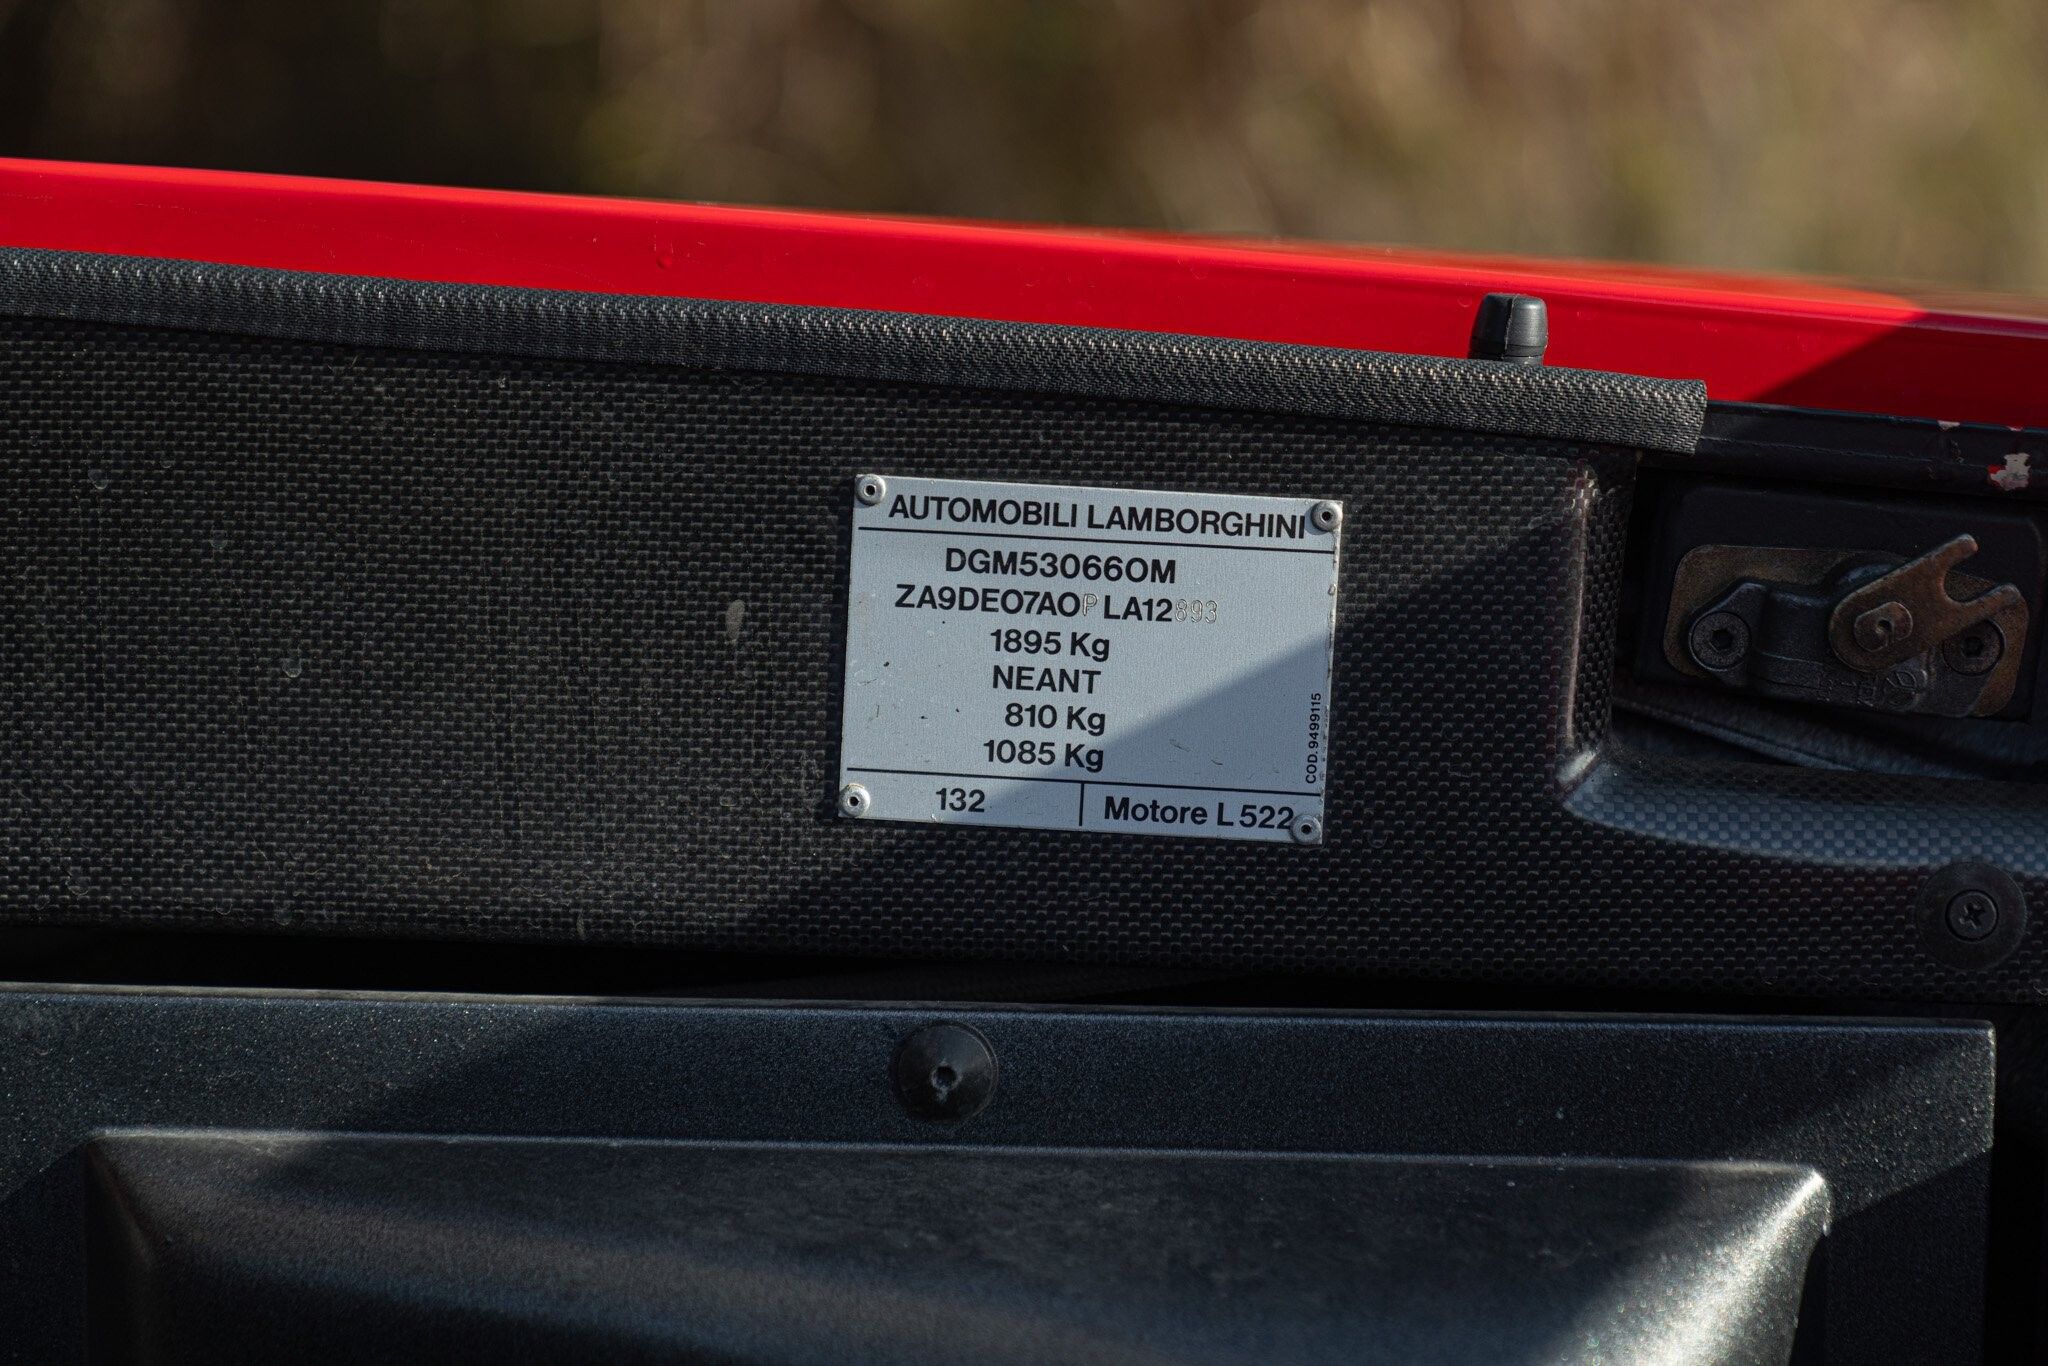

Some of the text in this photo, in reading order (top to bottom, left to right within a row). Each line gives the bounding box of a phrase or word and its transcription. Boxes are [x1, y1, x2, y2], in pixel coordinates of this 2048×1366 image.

[888, 494, 1306, 540] AUTOMOBILI LAMBORGHINI
[990, 628, 1110, 662] 1895 Kg
[992, 664, 1102, 695] NEANT
[1004, 703, 1106, 737] 810 Kg
[1305, 692, 1322, 784] COD.9499115
[983, 739, 1104, 774] 1085 Kg
[935, 787, 986, 814] 132
[1104, 795, 1208, 826] Motore
